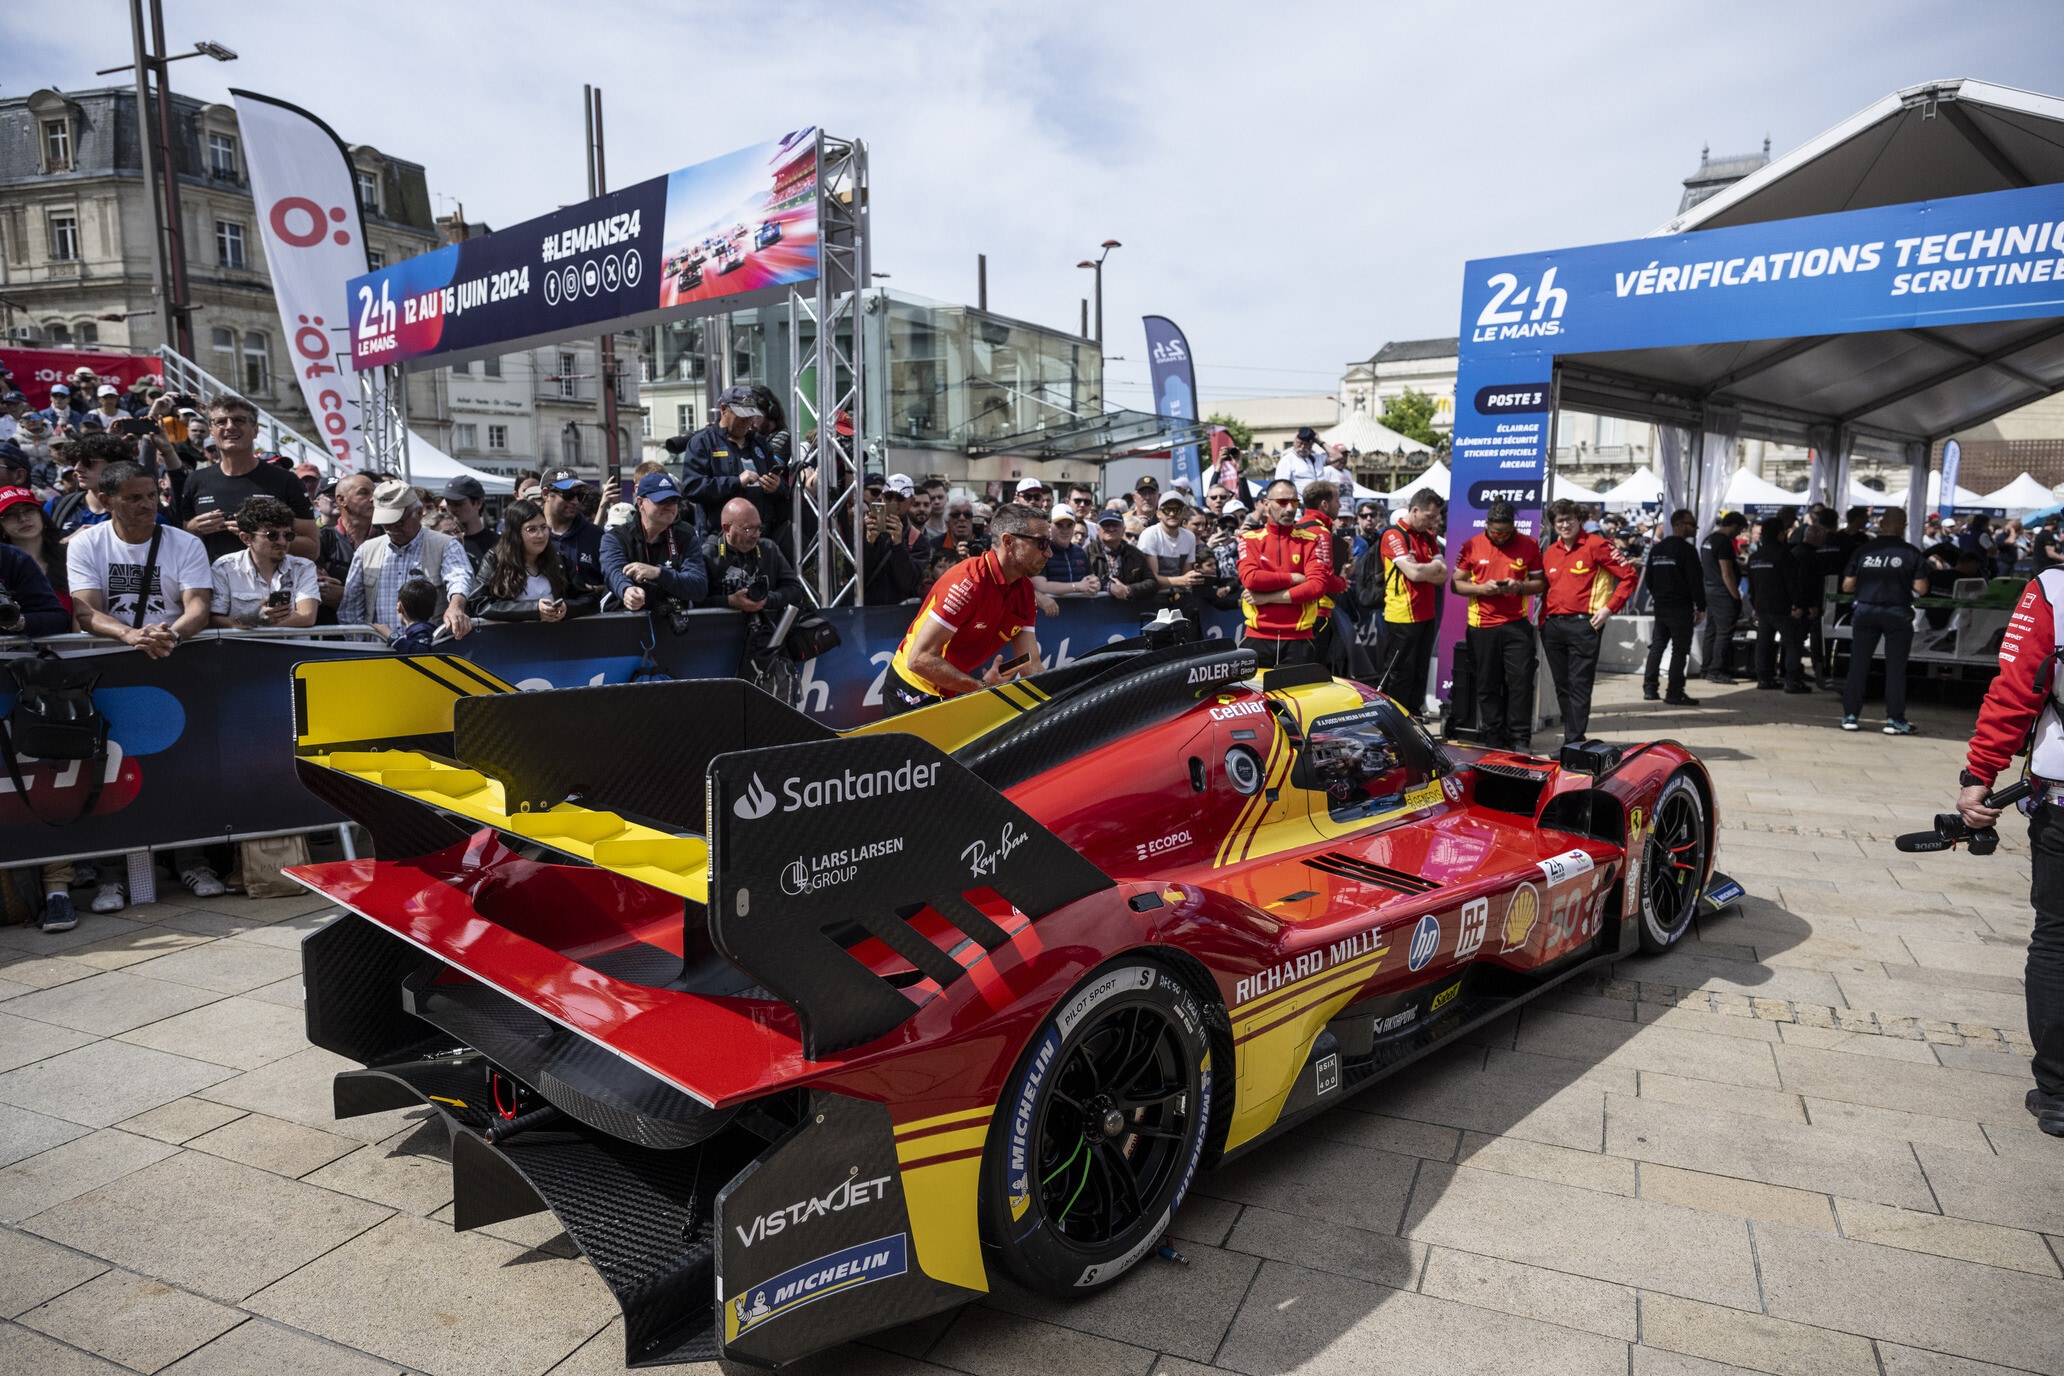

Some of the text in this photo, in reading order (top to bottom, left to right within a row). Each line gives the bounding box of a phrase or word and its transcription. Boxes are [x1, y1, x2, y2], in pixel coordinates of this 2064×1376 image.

[542, 209, 641, 264] #LEMANS24
[1615, 241, 1885, 298] VÉRIFICATIONS
[358, 278, 396, 340] 24h
[403, 265, 530, 325] 12 AU 16 JUIN 2024
[1476, 266, 1568, 327] 24h
[358, 333, 396, 357] LE MANS
[1472, 320, 1561, 343] LE MANS
[66, 374, 121, 385] crse
[1487, 392, 1542, 407] POSTE 3
[1455, 433, 1539, 446] ÉLÉMENTS DE SÉCURITÉ
[1496, 423, 1539, 433] ÉCLAIRAGE
[1464, 448, 1537, 458] STICKERS OFFICIELS
[1499, 460, 1536, 469] ARCEAUX
[1525, 490, 1535, 501] 4
[1187, 663, 1230, 684] ADLER
[1209, 700, 1267, 721] Cetilar
[782, 759, 942, 813] Santander
[812, 837, 904, 872] LARS LARSEN
[1149, 830, 1193, 852] ECOPOL
[812, 865, 858, 890] GROUP
[1545, 888, 1583, 950] 50
[1409, 916, 1440, 971] hp
[1236, 926, 1383, 1004] RICHARD MILLE
[1064, 969, 1151, 1028] PILOT SPORT S
[1319, 1075, 1336, 1090] 400
[1011, 1040, 1055, 1170] MICHELIN
[1176, 1093, 1211, 1207] MICHELIN
[735, 1172, 892, 1248] VISTAJET
[774, 1251, 890, 1305] MICHELIN
